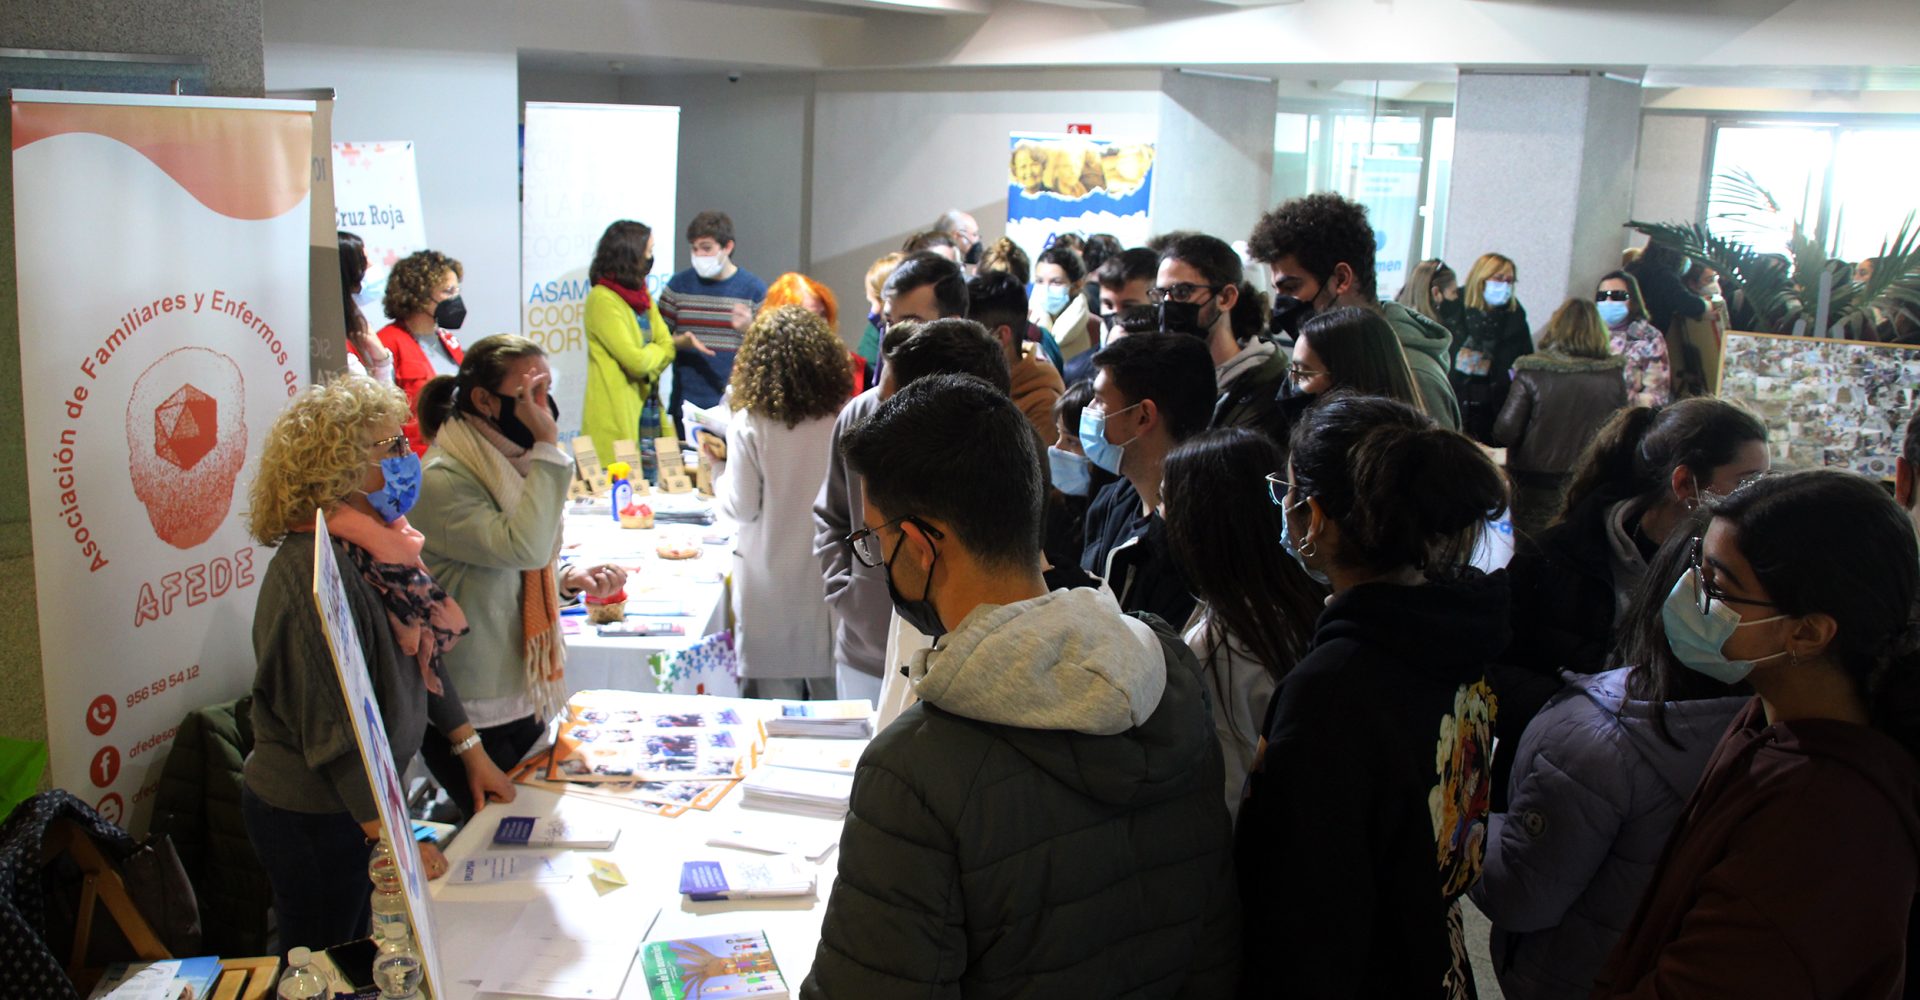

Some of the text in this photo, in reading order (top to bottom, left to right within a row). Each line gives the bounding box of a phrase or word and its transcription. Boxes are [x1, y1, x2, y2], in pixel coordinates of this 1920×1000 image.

[368, 204, 405, 230] Roja
[529, 279, 591, 304] ASAM
[53, 289, 298, 573] Asociación de Familiares y Enfermos de
[134, 547, 255, 628] AFEDE
[126, 664, 200, 708] 956 59 54 12
[129, 725, 181, 759] afedesa
[132, 780, 160, 805] afed
